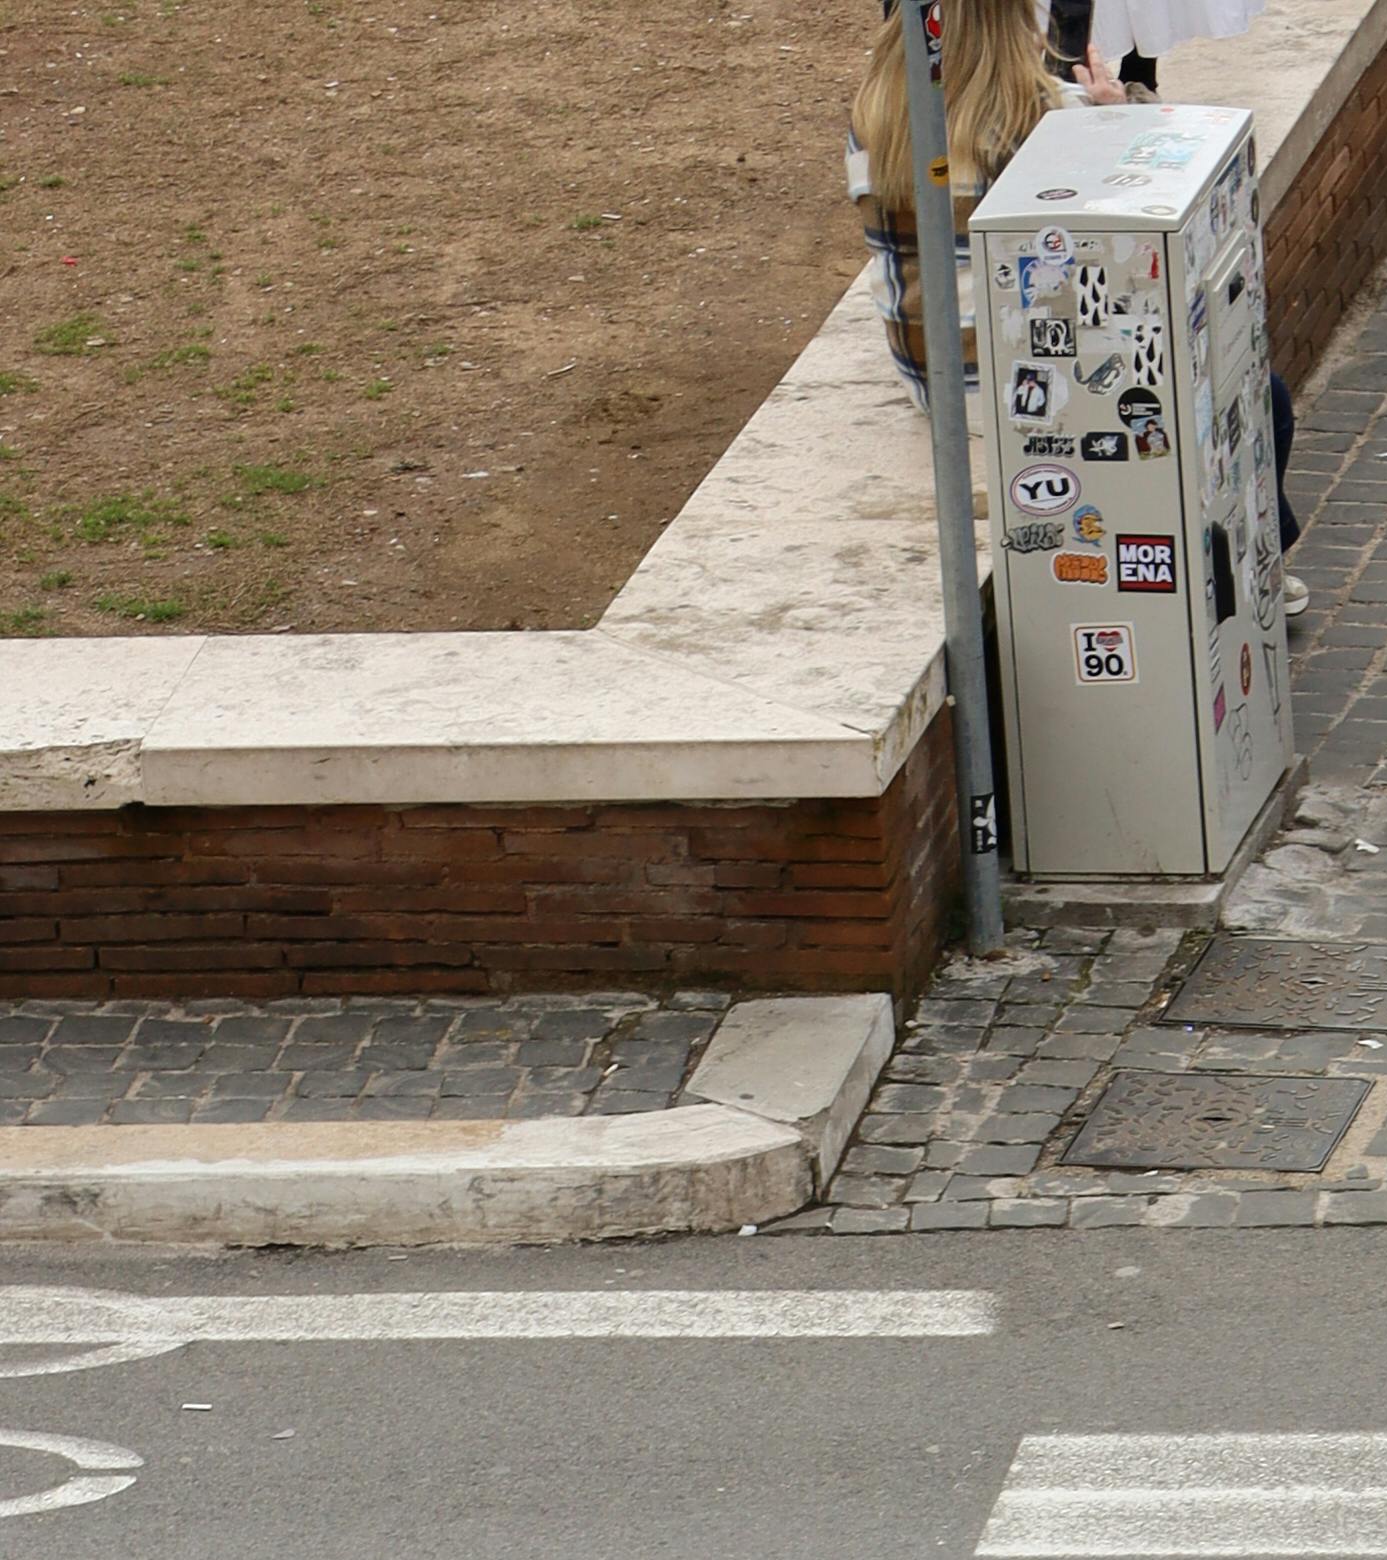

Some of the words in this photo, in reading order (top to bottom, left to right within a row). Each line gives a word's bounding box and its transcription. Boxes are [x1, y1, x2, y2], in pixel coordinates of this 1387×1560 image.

[1019, 477, 1070, 500] YU
[1119, 543, 1171, 563] MOR
[1120, 564, 1172, 582] ENA
